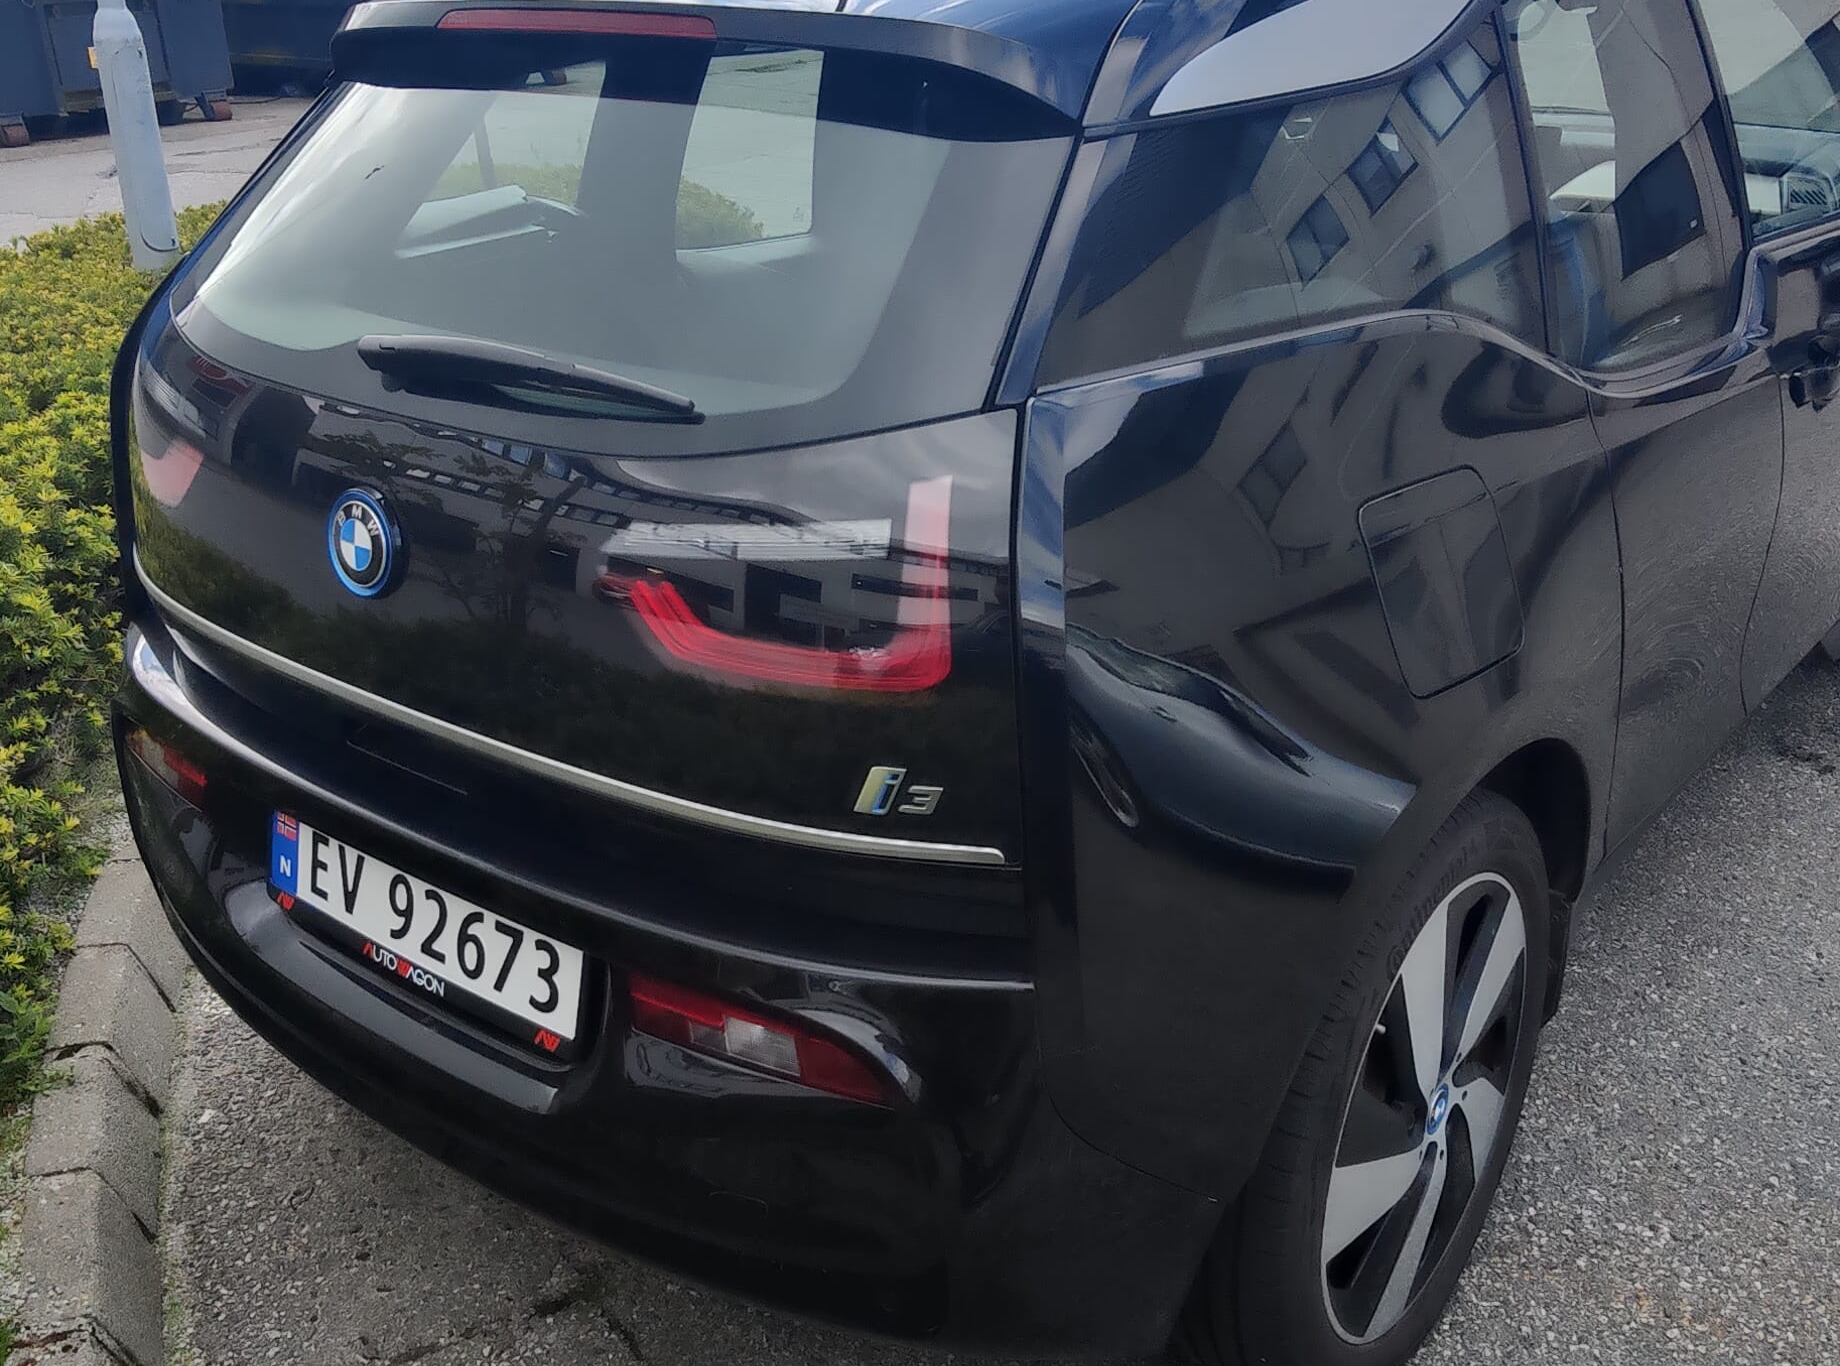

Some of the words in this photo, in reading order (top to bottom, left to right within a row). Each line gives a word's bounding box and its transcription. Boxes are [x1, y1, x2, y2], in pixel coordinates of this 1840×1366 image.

[853, 766, 944, 815] i3
[280, 855, 291, 877] N
[311, 830, 364, 914] EV
[389, 874, 559, 1014] 92673
